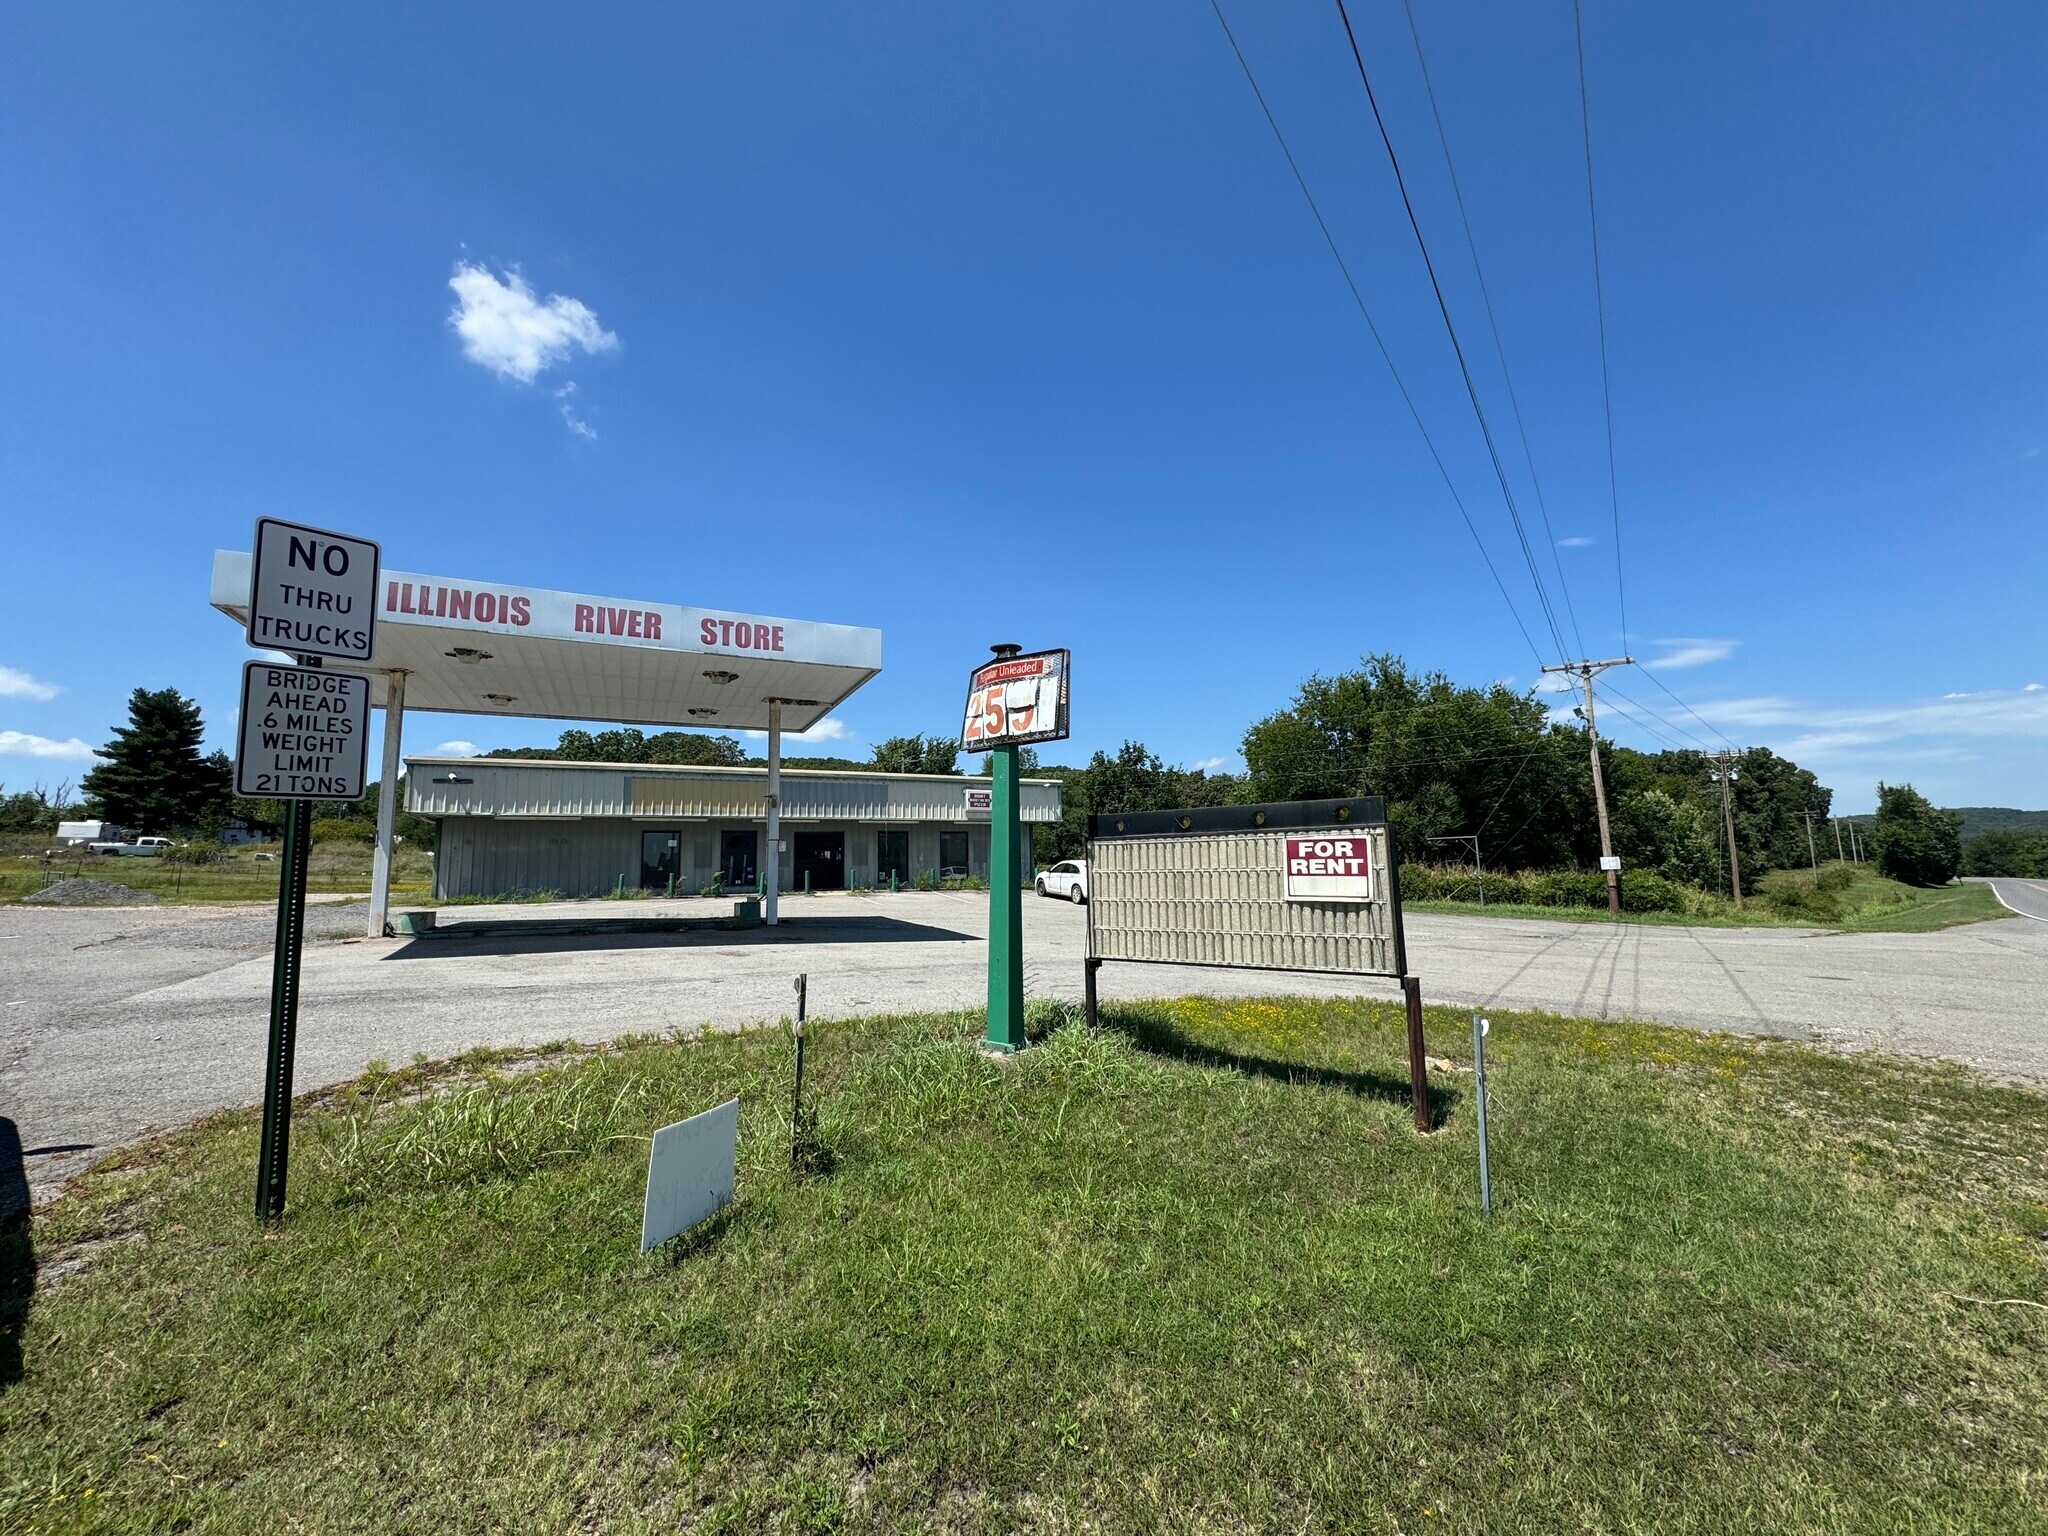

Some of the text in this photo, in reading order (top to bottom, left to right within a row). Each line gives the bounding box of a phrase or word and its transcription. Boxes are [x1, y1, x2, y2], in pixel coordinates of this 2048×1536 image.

[288, 536, 350, 577] NO
[280, 584, 353, 615] THRU
[386, 581, 785, 652] ILLINOIS RIVER STORE
[257, 615, 368, 651] TRUCKS
[1000, 661, 1038, 677] Unleaded
[267, 670, 352, 696] BRIDGE
[266, 691, 348, 715] AHEAD
[257, 712, 354, 736] .6 MILES
[261, 731, 348, 754] WEIGHT
[274, 754, 335, 774] LIMIT
[255, 773, 348, 795] 21 TONS
[1298, 841, 1354, 858] FOR
[1290, 858, 1364, 875] RENT
